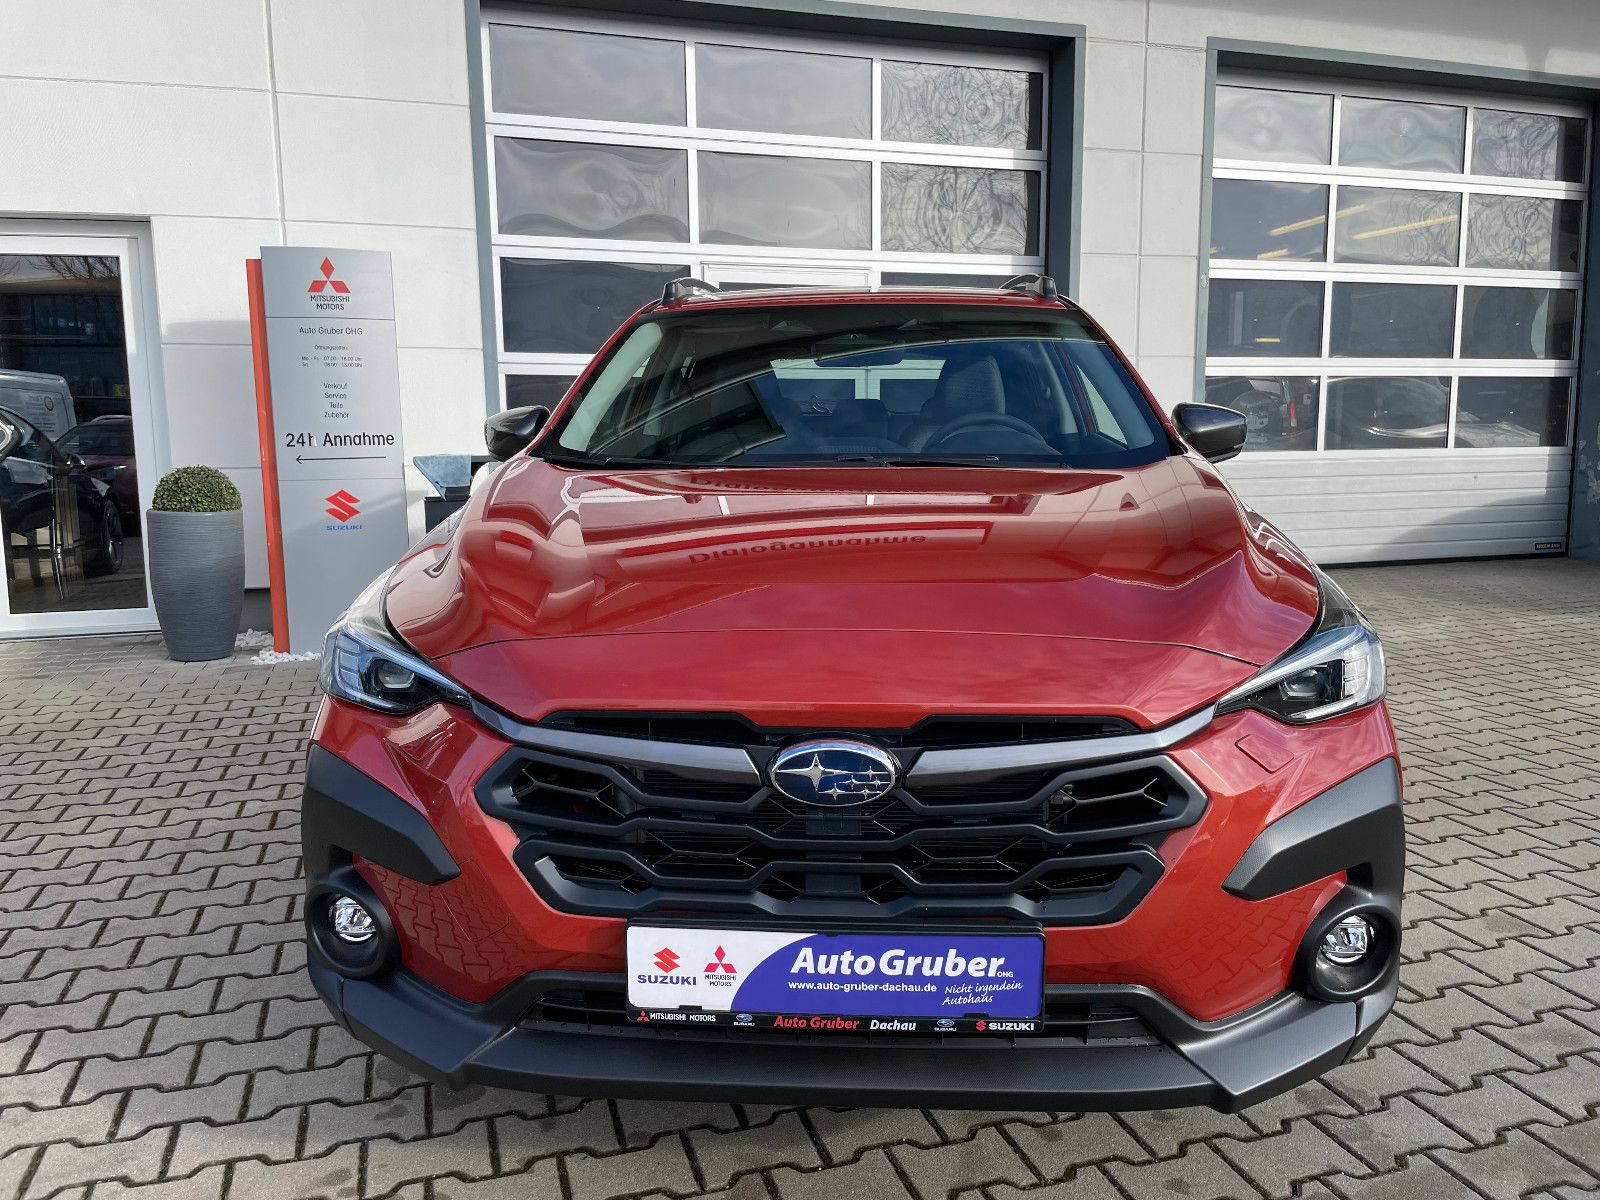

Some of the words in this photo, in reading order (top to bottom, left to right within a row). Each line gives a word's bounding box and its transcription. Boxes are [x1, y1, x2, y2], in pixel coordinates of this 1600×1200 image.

[299, 326, 317, 334] Auto
[318, 326, 343, 335] Gruber
[345, 327, 363, 335] OHG
[323, 432, 395, 446] Annahme
[637, 974, 697, 985] SUZUKI
[788, 981, 937, 993] www.auto-gruber-dachau.de
[944, 982, 972, 995] Nicht
[975, 980, 1023, 995] irgendein
[942, 993, 994, 1005] Autohaus
[650, 1012, 686, 1021] MITSUBISHI
[689, 1014, 716, 1022] MOTORS
[774, 1015, 807, 1028] Auto
[810, 1016, 860, 1030] Gruber
[870, 1019, 916, 1031] Dachau
[988, 1022, 1035, 1031] SUZUKI
